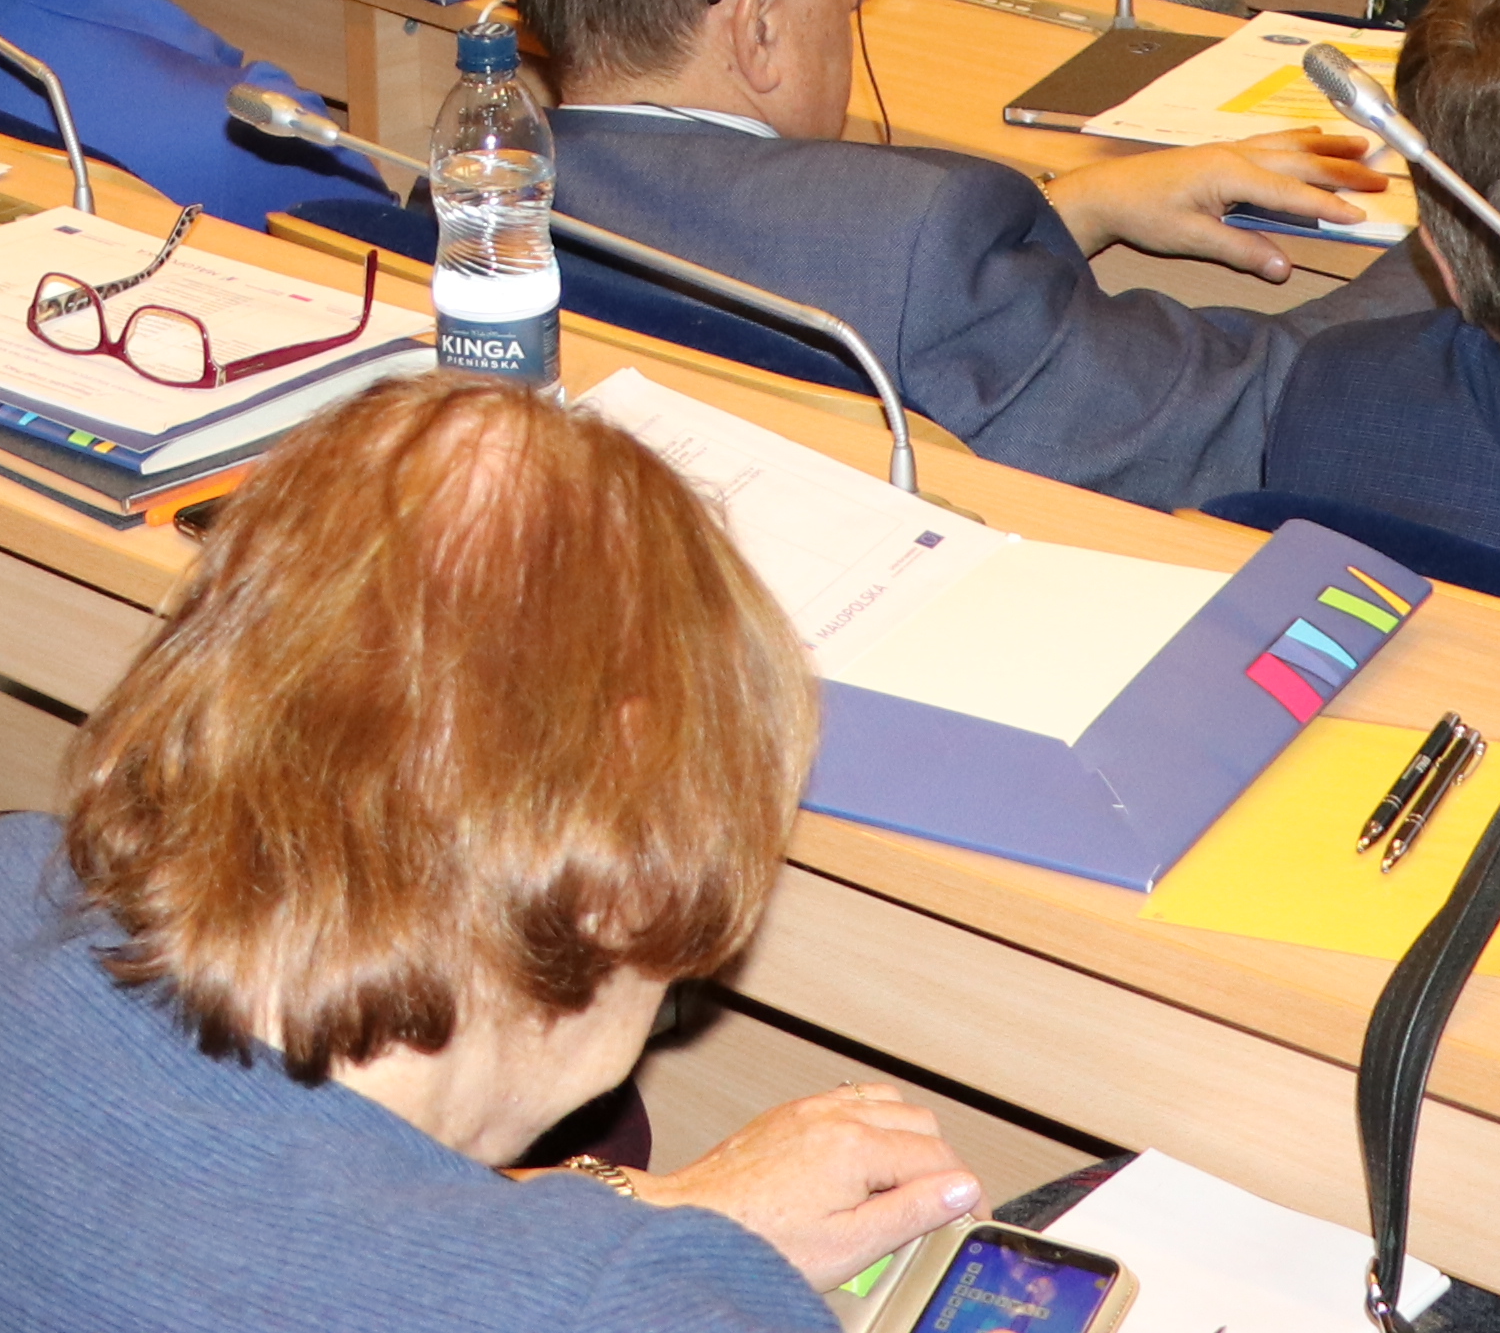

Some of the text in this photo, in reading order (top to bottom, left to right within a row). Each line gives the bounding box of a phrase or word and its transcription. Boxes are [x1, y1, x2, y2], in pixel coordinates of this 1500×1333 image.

[441, 334, 526, 360] KINGA
[446, 354, 521, 371] PIENIŃSKA
[815, 582, 888, 640] MAŁOPOLSKA
